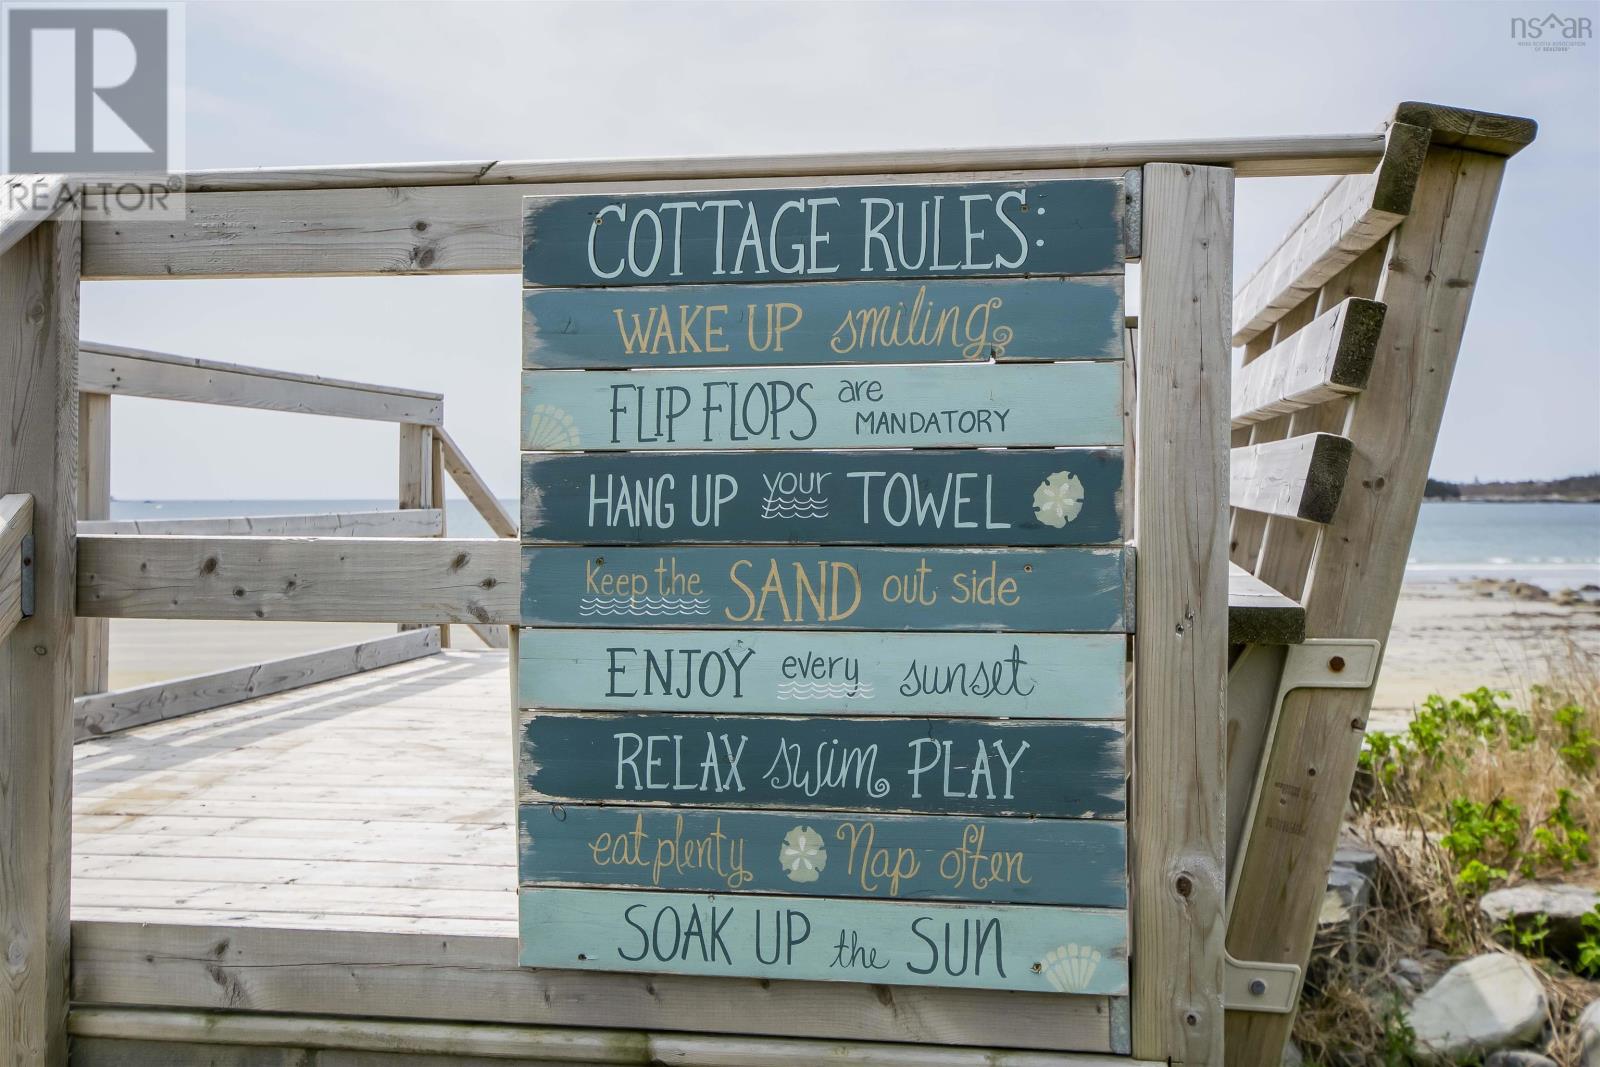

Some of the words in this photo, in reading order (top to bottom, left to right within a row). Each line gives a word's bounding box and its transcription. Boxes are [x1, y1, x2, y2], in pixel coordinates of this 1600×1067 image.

[586, 196, 840, 280] COTTAGE
[860, 189, 1048, 274] RULES:
[613, 304, 729, 355] WAKE
[747, 302, 803, 352] UP
[830, 285, 1013, 360] smiling
[609, 383, 691, 444] FLIP
[702, 381, 818, 442] FLOPS
[838, 379, 883, 403] are
[855, 408, 1010, 436] MANDATORY
[588, 474, 675, 529] HANG
[691, 474, 739, 527] UP
[762, 471, 832, 513] your
[846, 471, 1012, 530] TOWEL
[654, 557, 702, 597] the
[724, 558, 862, 623] SAND
[882, 558, 936, 606] out
[951, 560, 1020, 606] side
[605, 646, 756, 698] ENJOY
[782, 651, 860, 698] every
[899, 644, 1036, 697] sunset
[613, 731, 749, 792] RELAX
[762, 737, 890, 797] swim
[907, 738, 1030, 799] PLAY
[589, 813, 650, 866] eat
[652, 815, 754, 888] plenty
[836, 822, 920, 897] Nap
[939, 823, 1032, 890] often
[617, 903, 734, 965] SOAK
[755, 909, 811, 966] UP
[828, 929, 890, 970] the
[906, 916, 1007, 979] SUN
